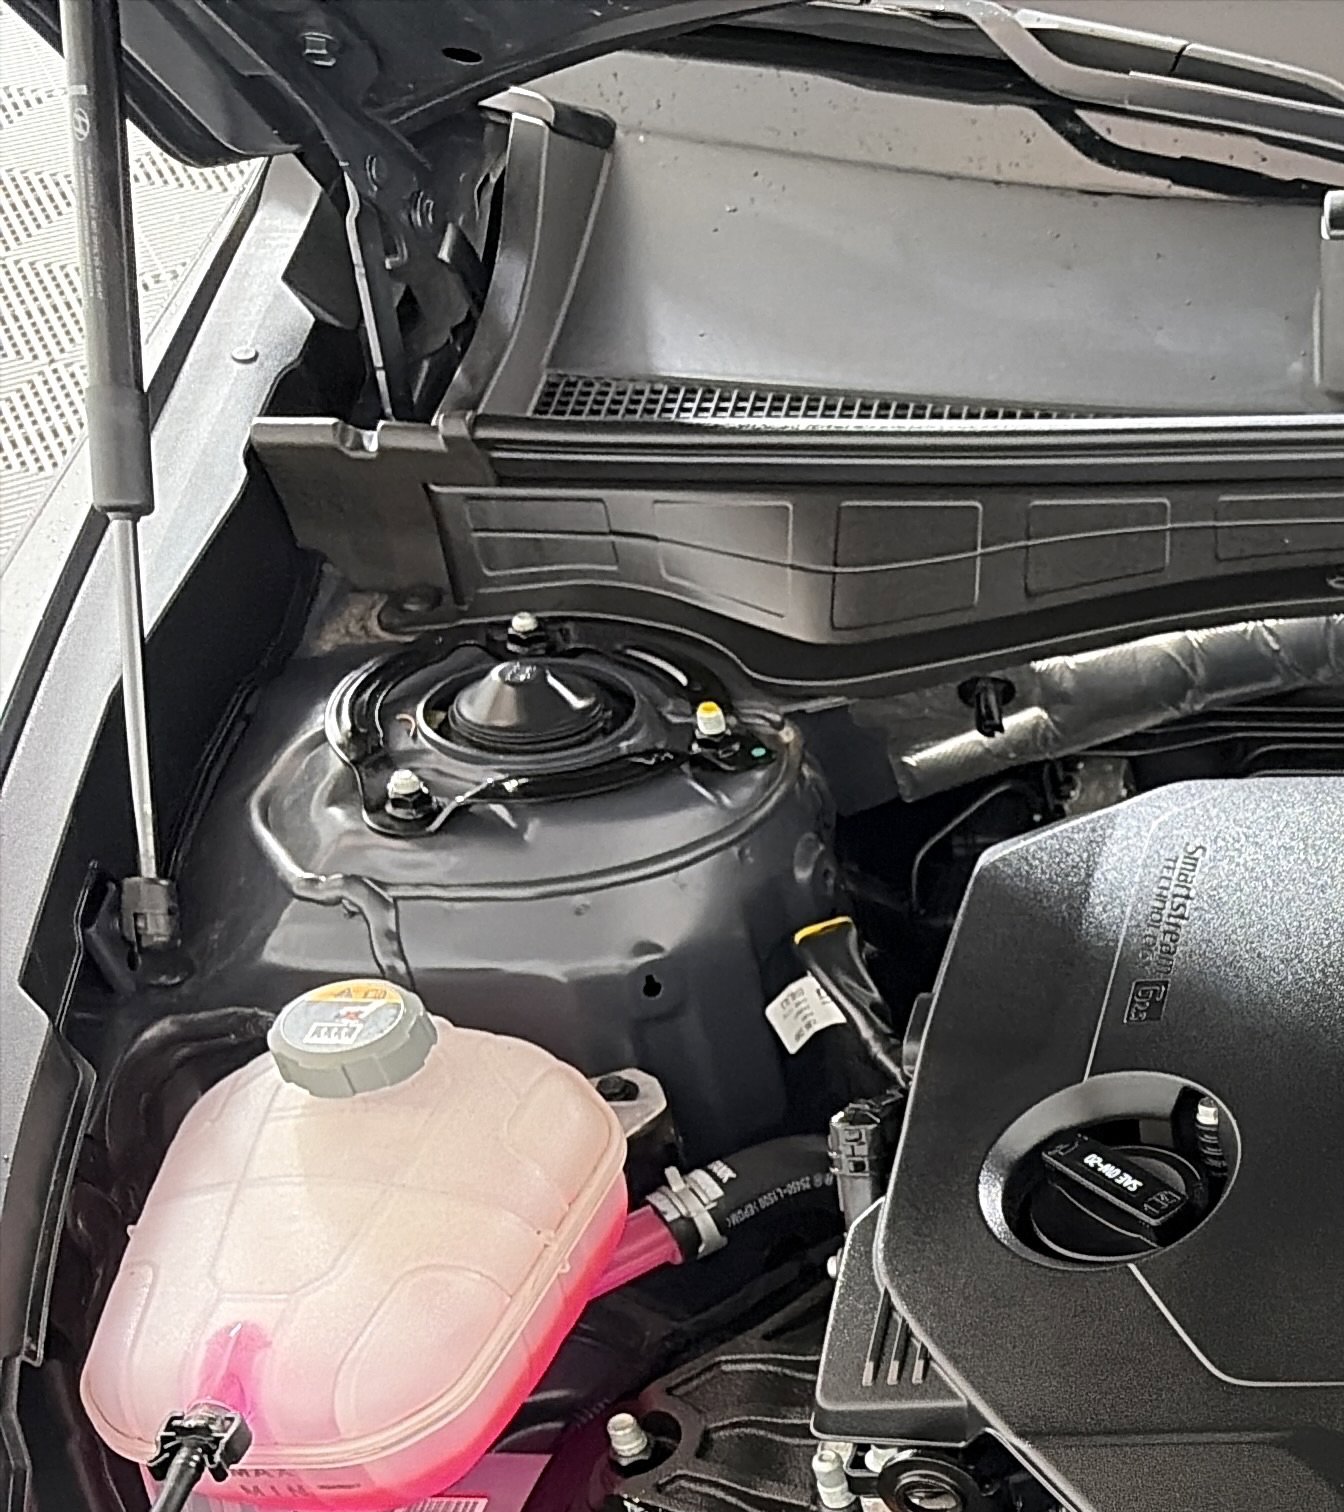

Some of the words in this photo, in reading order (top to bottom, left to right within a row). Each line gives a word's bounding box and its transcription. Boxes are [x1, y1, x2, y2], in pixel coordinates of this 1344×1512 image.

[1157, 842, 1208, 975] Smartstream
[1083, 1153, 1123, 1180] 0W-20
[1115, 1173, 1143, 1193] SAE
